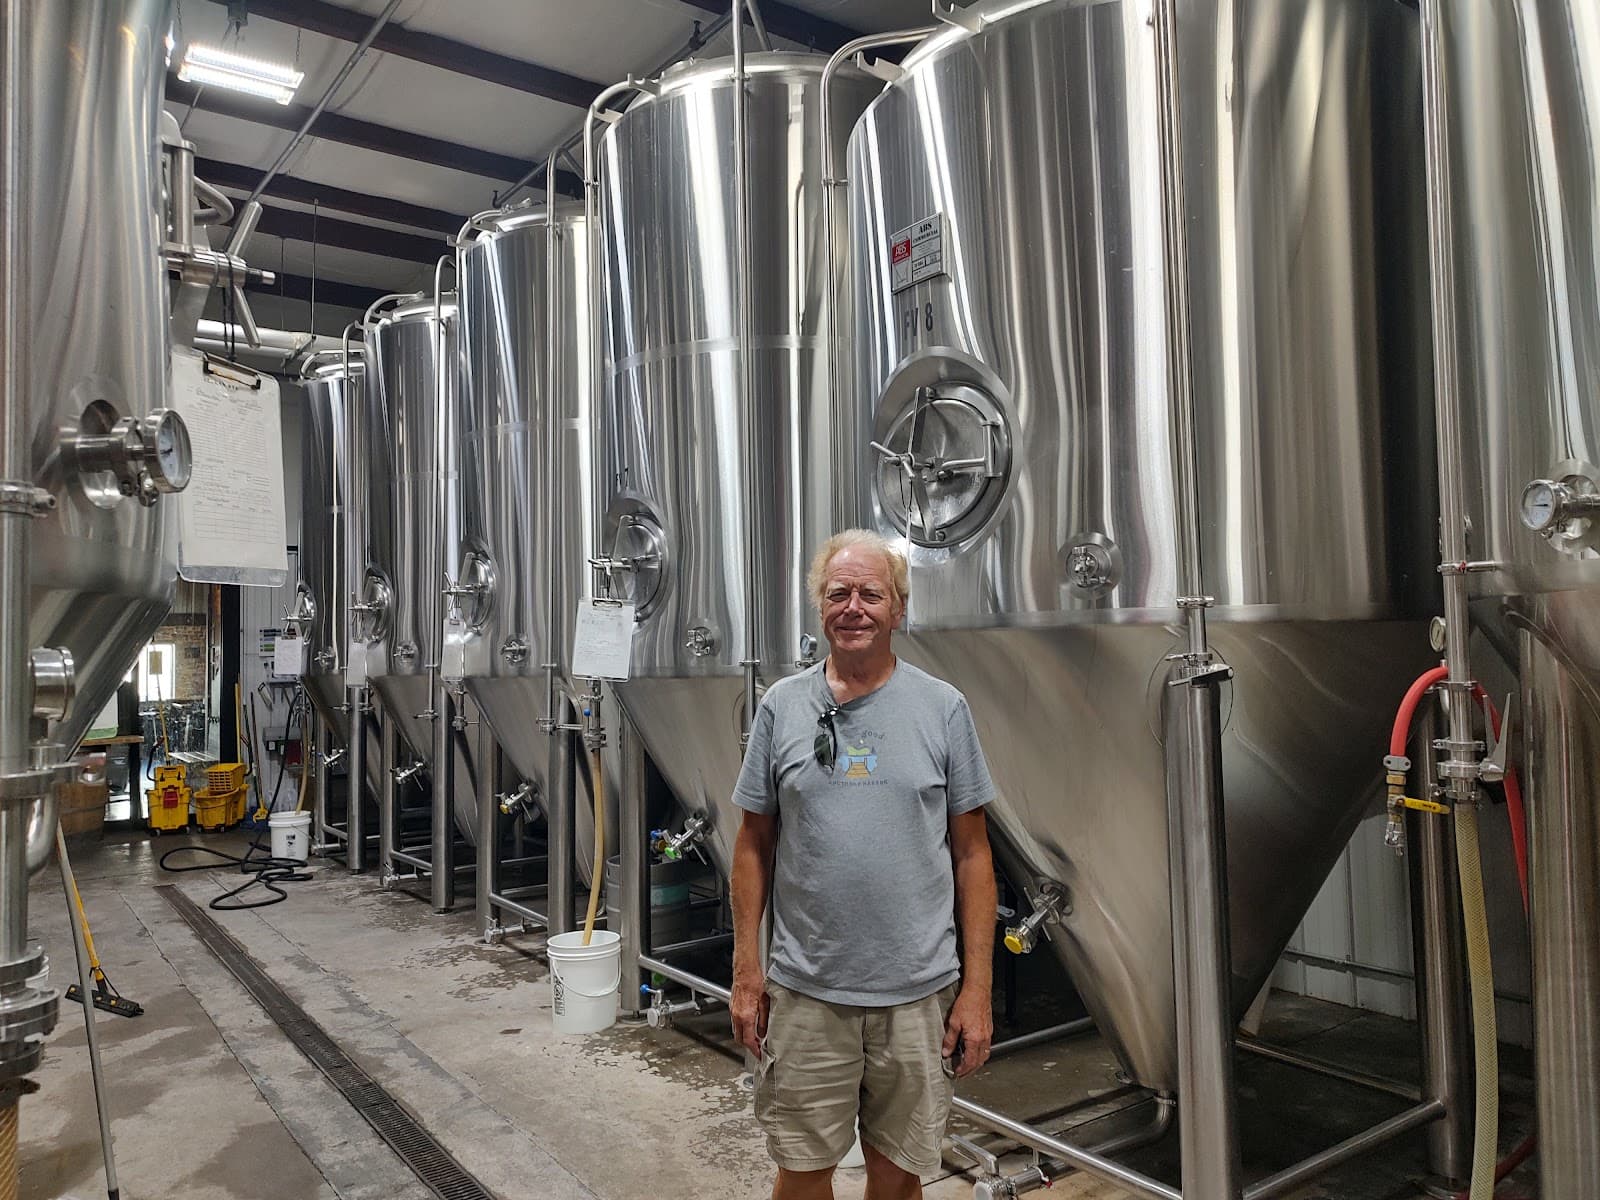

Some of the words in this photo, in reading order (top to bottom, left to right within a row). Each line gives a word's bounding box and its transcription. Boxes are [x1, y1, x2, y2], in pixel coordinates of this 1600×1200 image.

[919, 222, 932, 234] ABS
[895, 243, 907, 257] ABS
[904, 307, 918, 340] FV
[925, 302, 933, 332] 8
[861, 730, 885, 740] good
